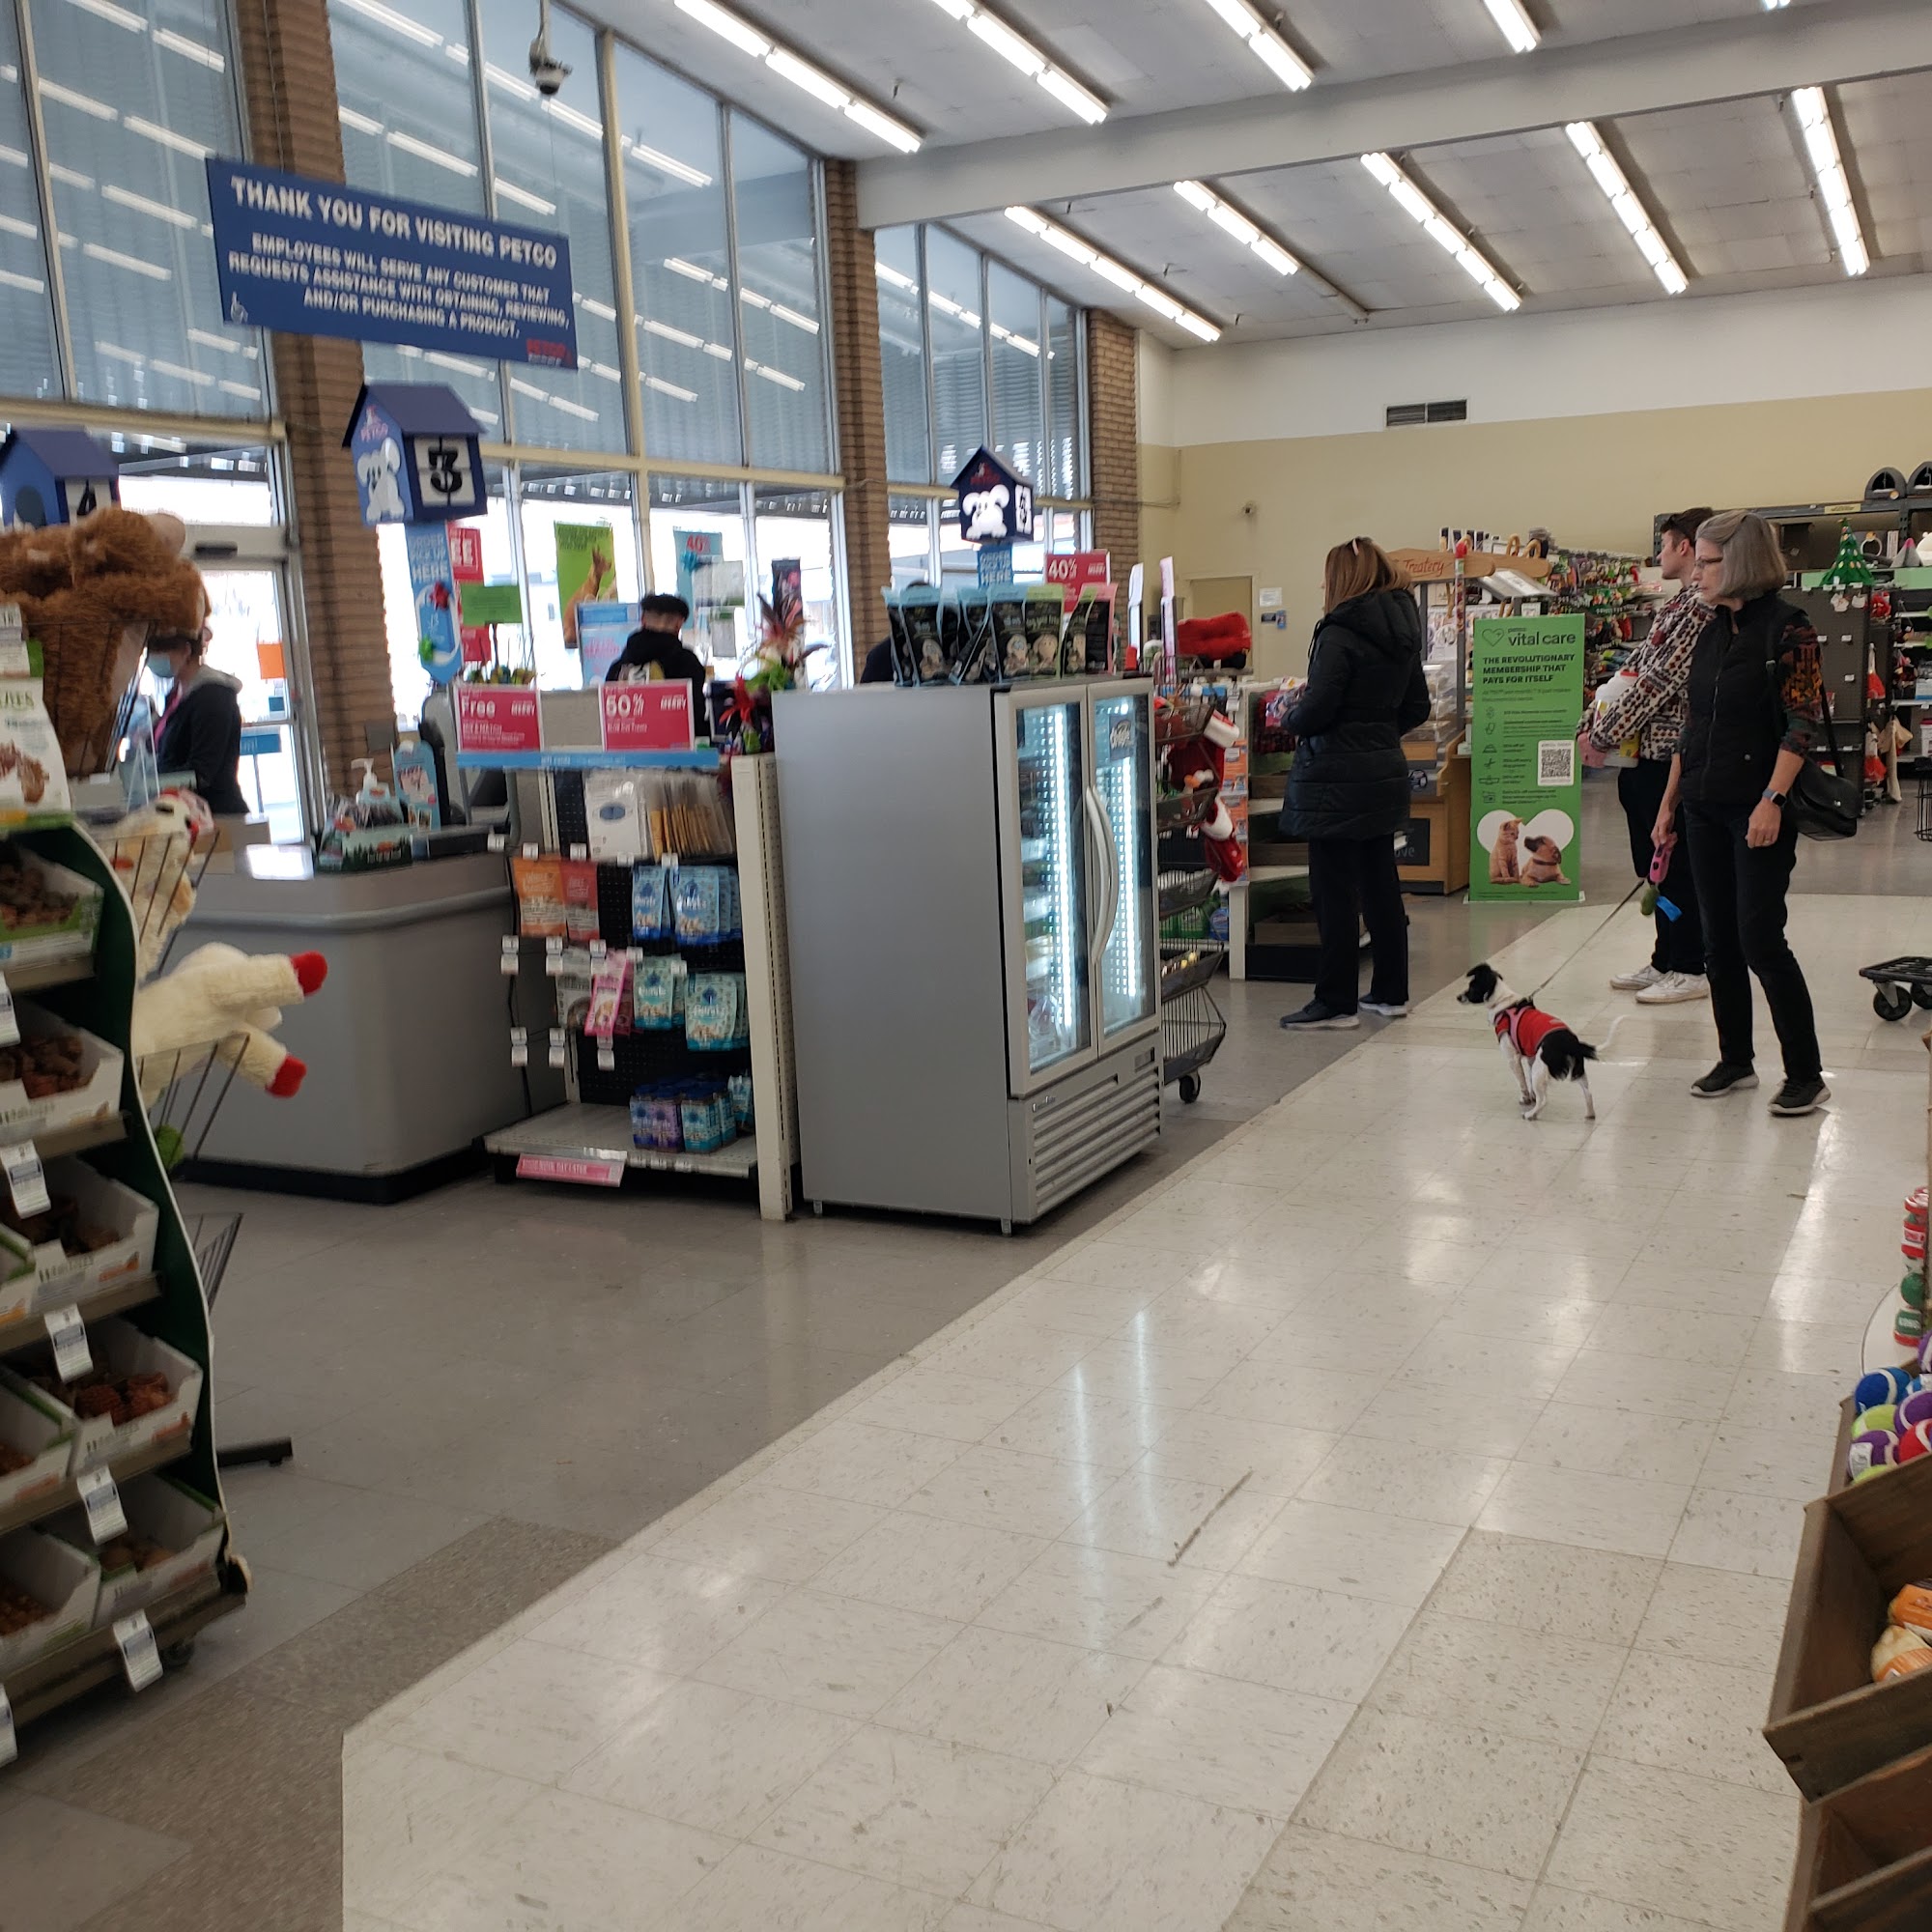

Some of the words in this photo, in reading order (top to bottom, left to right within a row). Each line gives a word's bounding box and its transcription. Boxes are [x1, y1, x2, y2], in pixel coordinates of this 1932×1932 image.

[231, 175, 313, 221] THANK
[318, 194, 362, 231] YOU
[369, 206, 411, 241] FOR
[415, 215, 495, 257] VISITING
[499, 234, 557, 270] PETCO
[252, 232, 341, 267] EMPLOYEES
[344, 249, 377, 274] WILL
[381, 257, 422, 282] SERVE
[426, 266, 450, 288] ANY
[453, 270, 519, 299] CUSTOMER
[521, 283, 550, 304] THAT
[229, 250, 309, 285] REQUESTS
[313, 266, 396, 298] ASSISTANCE
[399, 281, 432, 304] WITH
[436, 288, 503, 317] OBTAINING,
[505, 299, 570, 330] REVIEWING,
[304, 287, 359, 315] AND/OR
[362, 296, 445, 327] PURCHASING
[449, 311, 457, 330] A
[429, 446, 463, 493] 3
[412, 562, 449, 582] HERE
[1403, 557, 1444, 577] Treatery
[1508, 632, 1539, 646] vital
[1543, 634, 1577, 644] care
[1483, 666, 1541, 674] MEMBERSHIP
[1502, 654, 1576, 664] REVOLUTIONARY
[461, 696, 496, 719] Free
